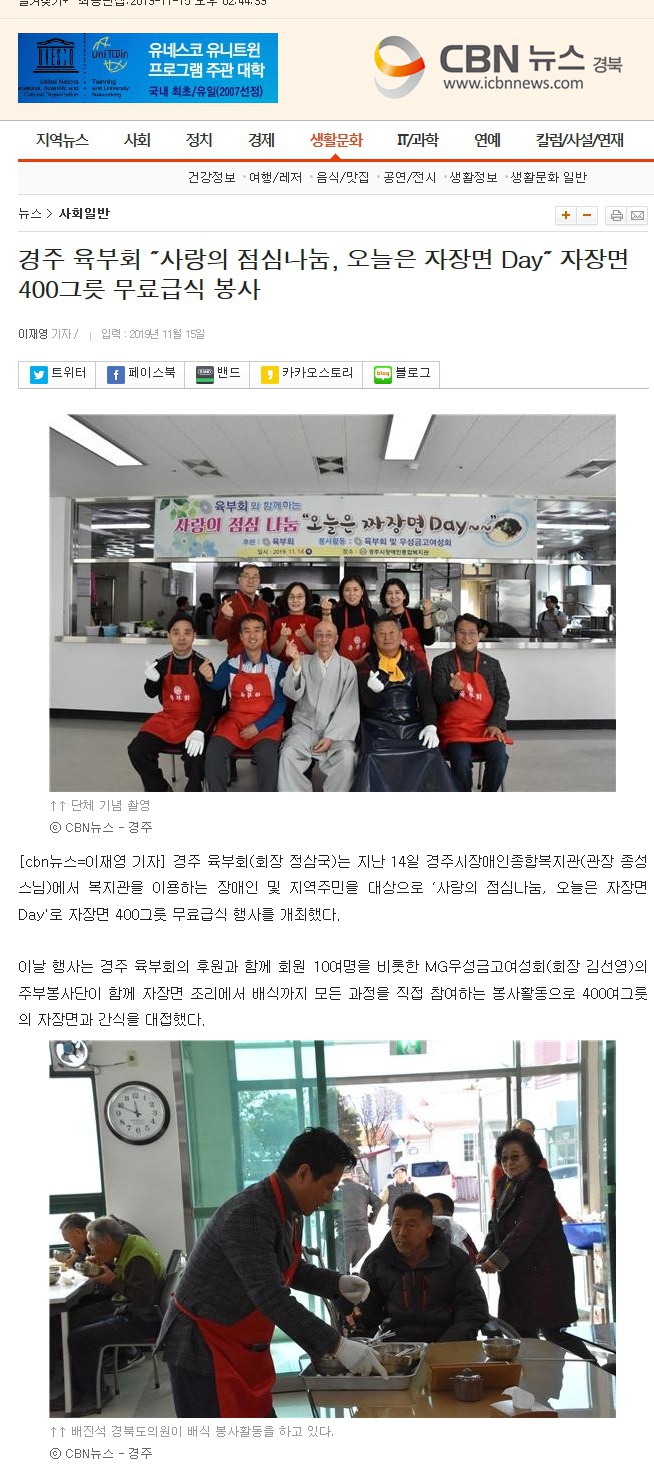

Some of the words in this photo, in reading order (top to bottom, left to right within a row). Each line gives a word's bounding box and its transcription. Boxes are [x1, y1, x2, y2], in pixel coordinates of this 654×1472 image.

[149, 42, 204, 58] 유네스코
[206, 42, 261, 58] 유니트윈
[440, 44, 519, 73] CBN
[529, 45, 585, 72] 뉴스
[593, 56, 623, 73] 경북
[148, 62, 203, 78] 프로그램
[206, 62, 234, 78] 주관
[237, 62, 265, 78] 대학
[443, 76, 584, 90] www.icbnnews.com
[149, 86, 169, 97] 국내
[172, 86, 263, 98] 최초/유일(2007선정)
[36, 133, 89, 148] 지역뉴스
[124, 133, 150, 147] 사회
[186, 133, 212, 147] 정치
[248, 133, 274, 147] 경제
[310, 133, 363, 147] 생활문화
[398, 133, 439, 147] IT/과학
[475, 133, 500, 147] 연예
[536, 133, 623, 147] 칼럼/사설/연재
[189, 172, 235, 183] 건강정보
[250, 172, 301, 183] 여행/레저
[317, 172, 368, 183] 음식/맛집
[384, 172, 435, 183] 공연/전시
[450, 172, 497, 183] 생활정보
[511, 172, 559, 183] 생활문화
[564, 172, 587, 183] 일반
[19, 208, 41, 219] 뉴스
[59, 208, 110, 219] 사회일반
[19, 249, 64, 270] 경주
[74, 249, 139, 270] 육부회
[238, 248, 337, 271] 점심나눔,
[347, 249, 416, 269] 오늘은
[425, 249, 491, 270] 자장면
[560, 249, 627, 270] 자장면
[19, 280, 105, 299] 400그릇
[114, 279, 203, 300] 무료급식
[214, 278, 261, 300] 봉사
[19, 329, 47, 339] 이재영
[52, 329, 71, 339] 기자
[102, 329, 120, 339] 입력
[130, 329, 158, 339] 2019년
[163, 329, 181, 339] 11월
[186, 329, 204, 339] 15일
[52, 367, 85, 378] 트위터
[129, 367, 175, 378] 페이스북
[218, 367, 240, 378] 밴드
[283, 367, 352, 378] 카카오스토리
[396, 367, 430, 378] 블로그
[215, 501, 248, 512] 육부회
[264, 501, 302, 511] 함께하는
[173, 516, 221, 533] 사랑의
[230, 516, 259, 533] 점심
[266, 516, 299, 533] 나눔
[362, 514, 425, 534] 짜장면
[272, 538, 295, 546] 육부회
[364, 538, 387, 546] 육부회
[72, 800, 93, 811] 단체
[100, 800, 121, 811] 기념
[128, 800, 149, 811] 촬영
[66, 822, 113, 833] CBN뉴스
[129, 822, 152, 833] 경주
[21, 855, 125, 868] [cbn뉴스=이재영
[133, 855, 164, 868] 기자]
[174, 855, 200, 868] 경주
[208, 855, 283, 868] 육부회(회장
[290, 855, 350, 868] 정삼국)는
[358, 855, 385, 868] 지난
[392, 855, 418, 868] 14일
[427, 855, 614, 868] 경주시장애인종합복지관(관장
[621, 855, 646, 868] 종성
[72, 1426, 105, 1437] 배진석
[112, 1426, 181, 1437] 경북도의원이
[188, 1426, 209, 1437] 배식
[216, 1426, 274, 1437] 봉사활동을
[279, 1426, 302, 1437] 하고
[308, 1426, 333, 1437] 있다.
[66, 1448, 113, 1459] CBN뉴스
[129, 1448, 152, 1459] 경주
